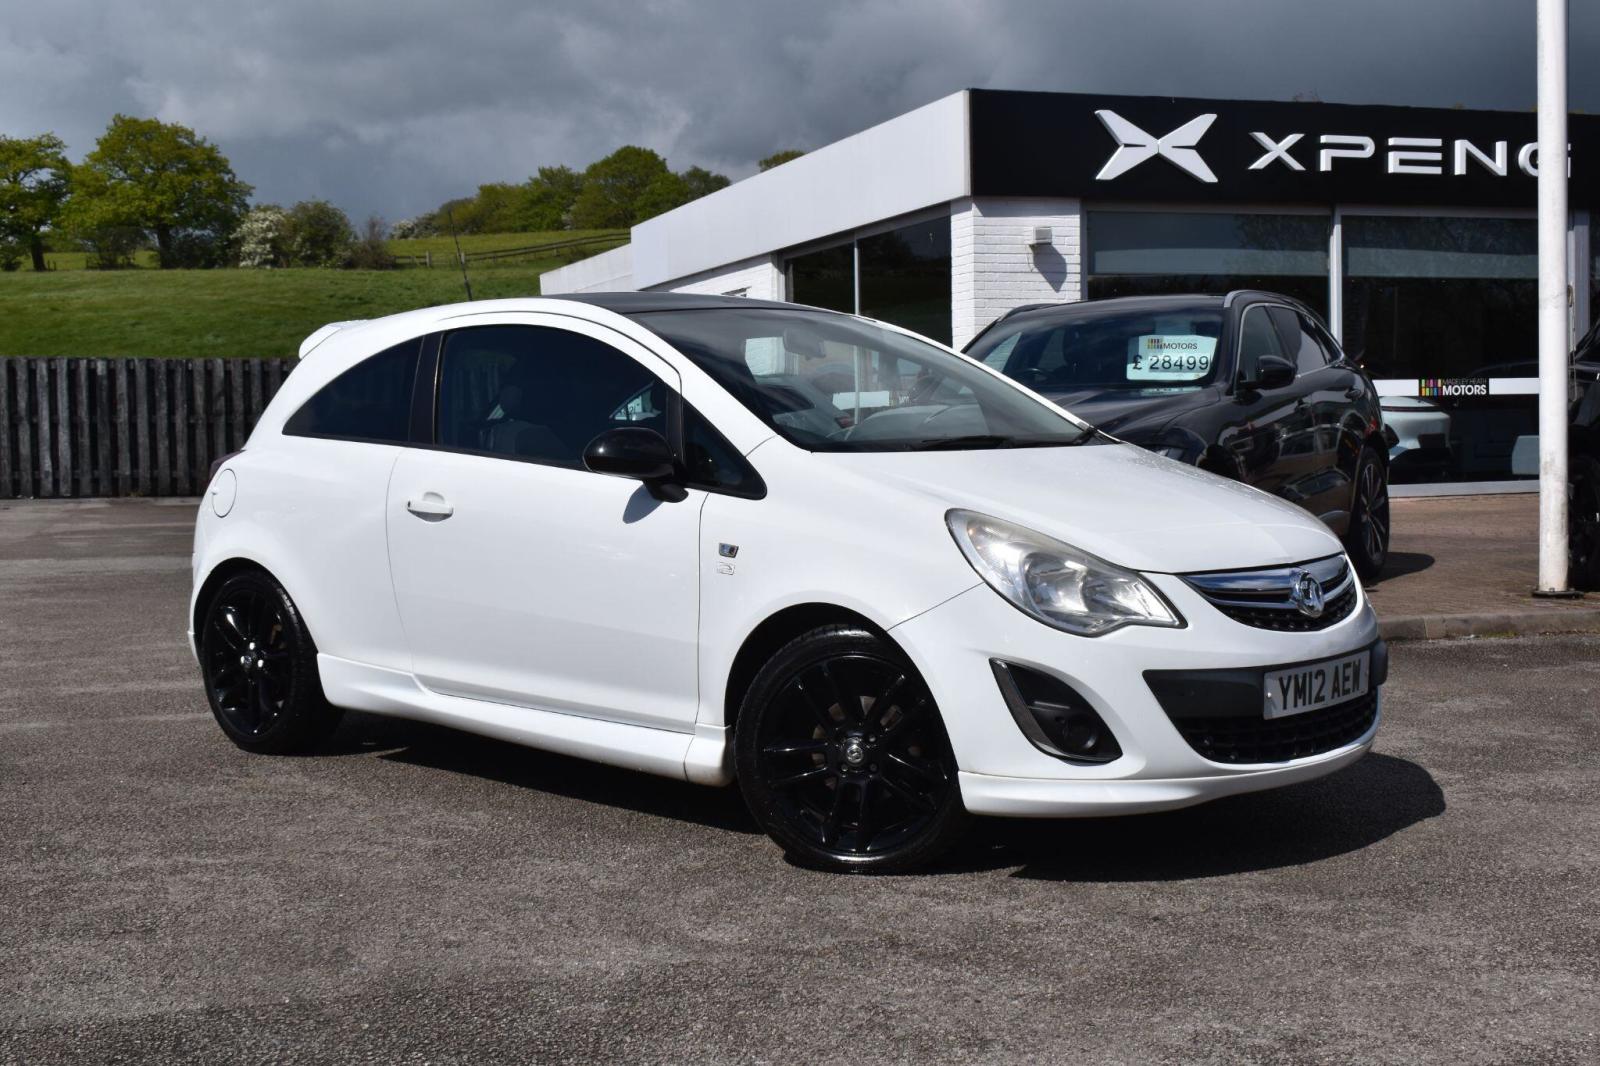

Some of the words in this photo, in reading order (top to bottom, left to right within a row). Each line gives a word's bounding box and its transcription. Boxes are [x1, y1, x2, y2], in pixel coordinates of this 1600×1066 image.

[1132, 354, 1142, 370] £
[1149, 355, 1209, 370] 28499
[1442, 385, 1487, 396] MOTORS
[1278, 670, 1326, 710] YM12
